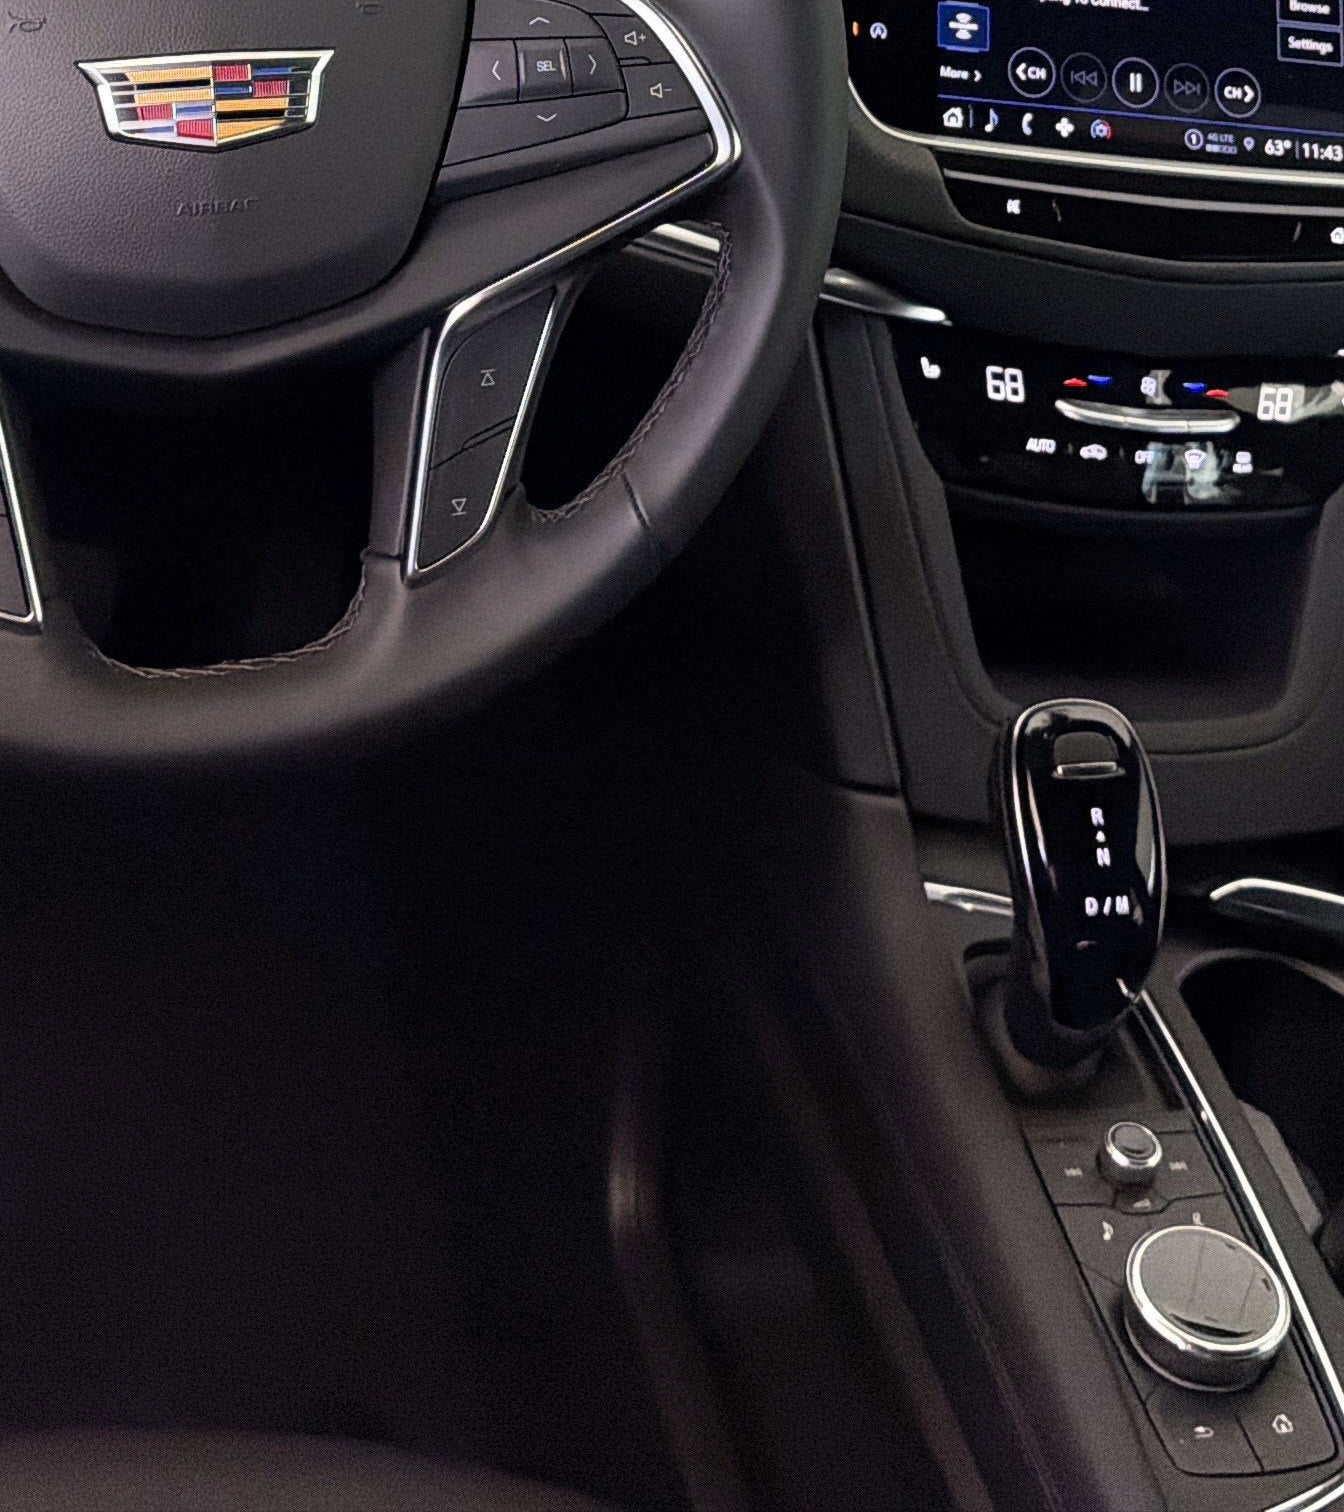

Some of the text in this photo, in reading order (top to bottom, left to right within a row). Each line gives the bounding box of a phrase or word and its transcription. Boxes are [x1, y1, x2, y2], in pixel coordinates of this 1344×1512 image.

[1288, 35, 1334, 56] Settings
[536, 60, 556, 73] SEL
[939, 65, 970, 80] More
[1027, 66, 1047, 80] CH
[1223, 86, 1243, 100] CH
[1301, 142, 1344, 162] 11:43
[985, 365, 1025, 403] 68
[1257, 385, 1293, 422] 68
[1026, 437, 1056, 454] AUTO
[1090, 807, 1104, 827] R
